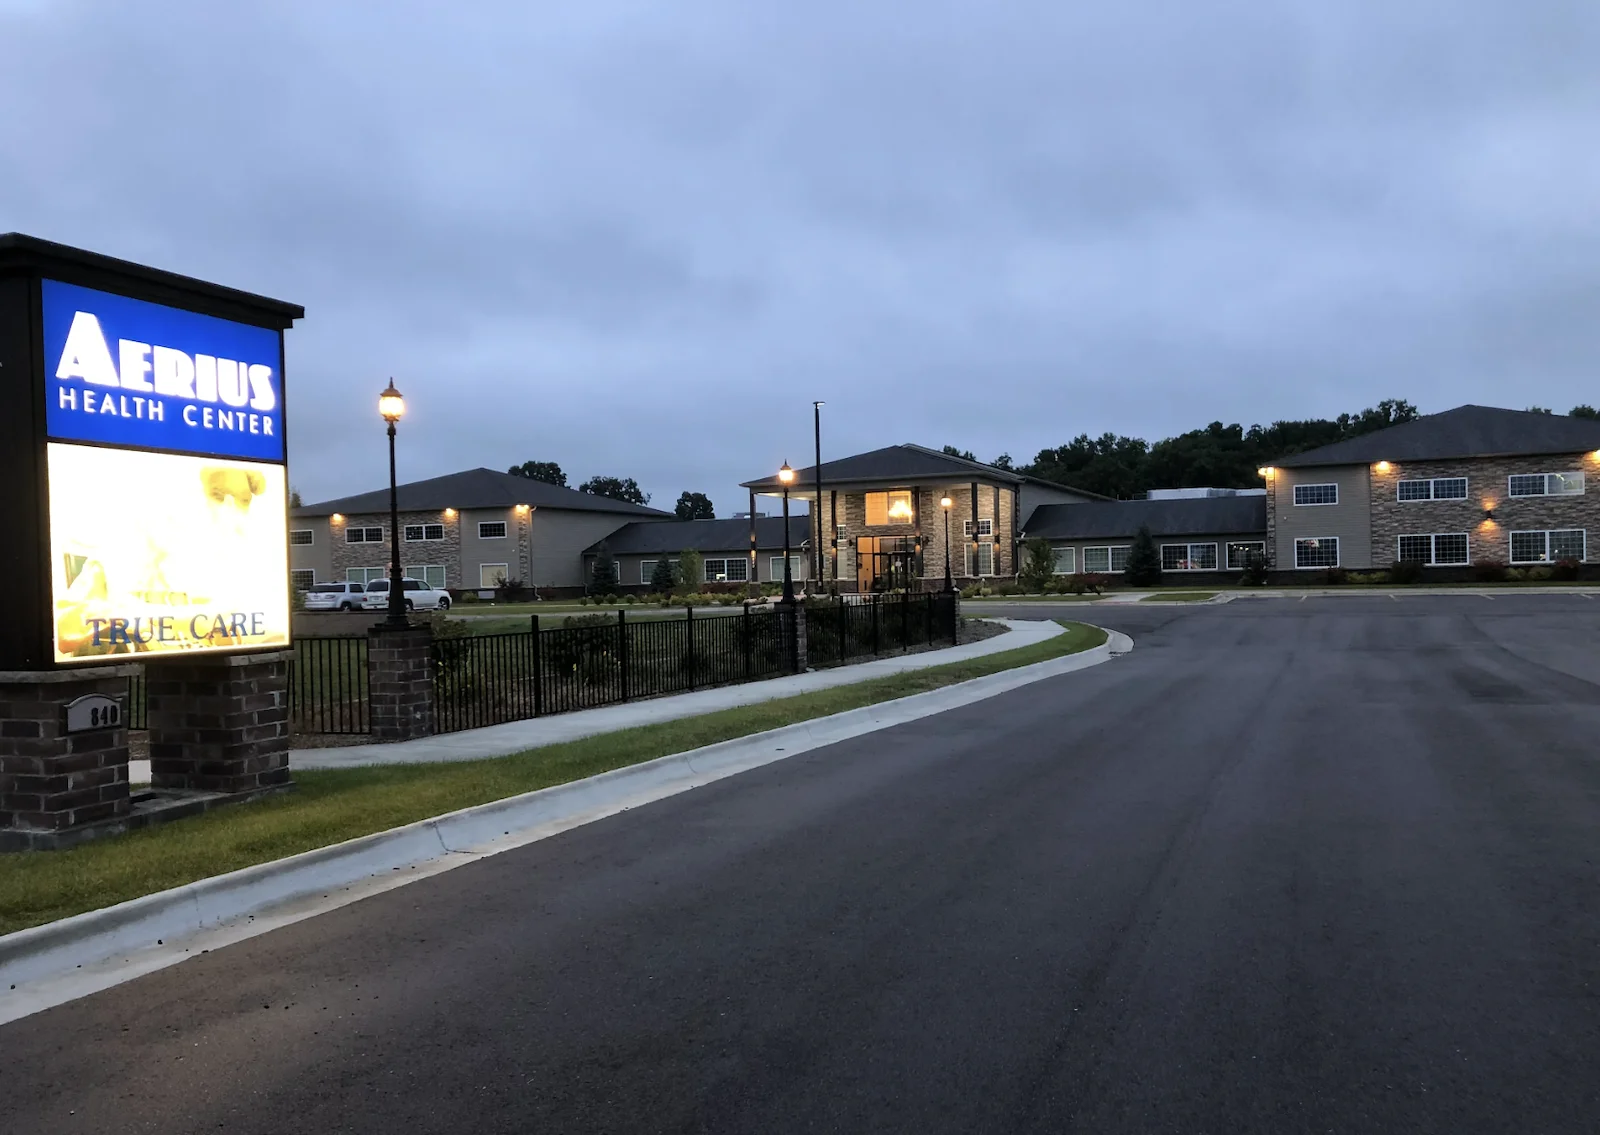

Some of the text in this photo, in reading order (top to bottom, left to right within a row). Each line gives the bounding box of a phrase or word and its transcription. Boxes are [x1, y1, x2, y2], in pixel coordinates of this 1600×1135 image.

[55, 311, 276, 411] AERIUS
[59, 387, 273, 436] HEALTH CENTER
[86, 612, 265, 646] TRUE CARE
[91, 705, 118, 727] 840
